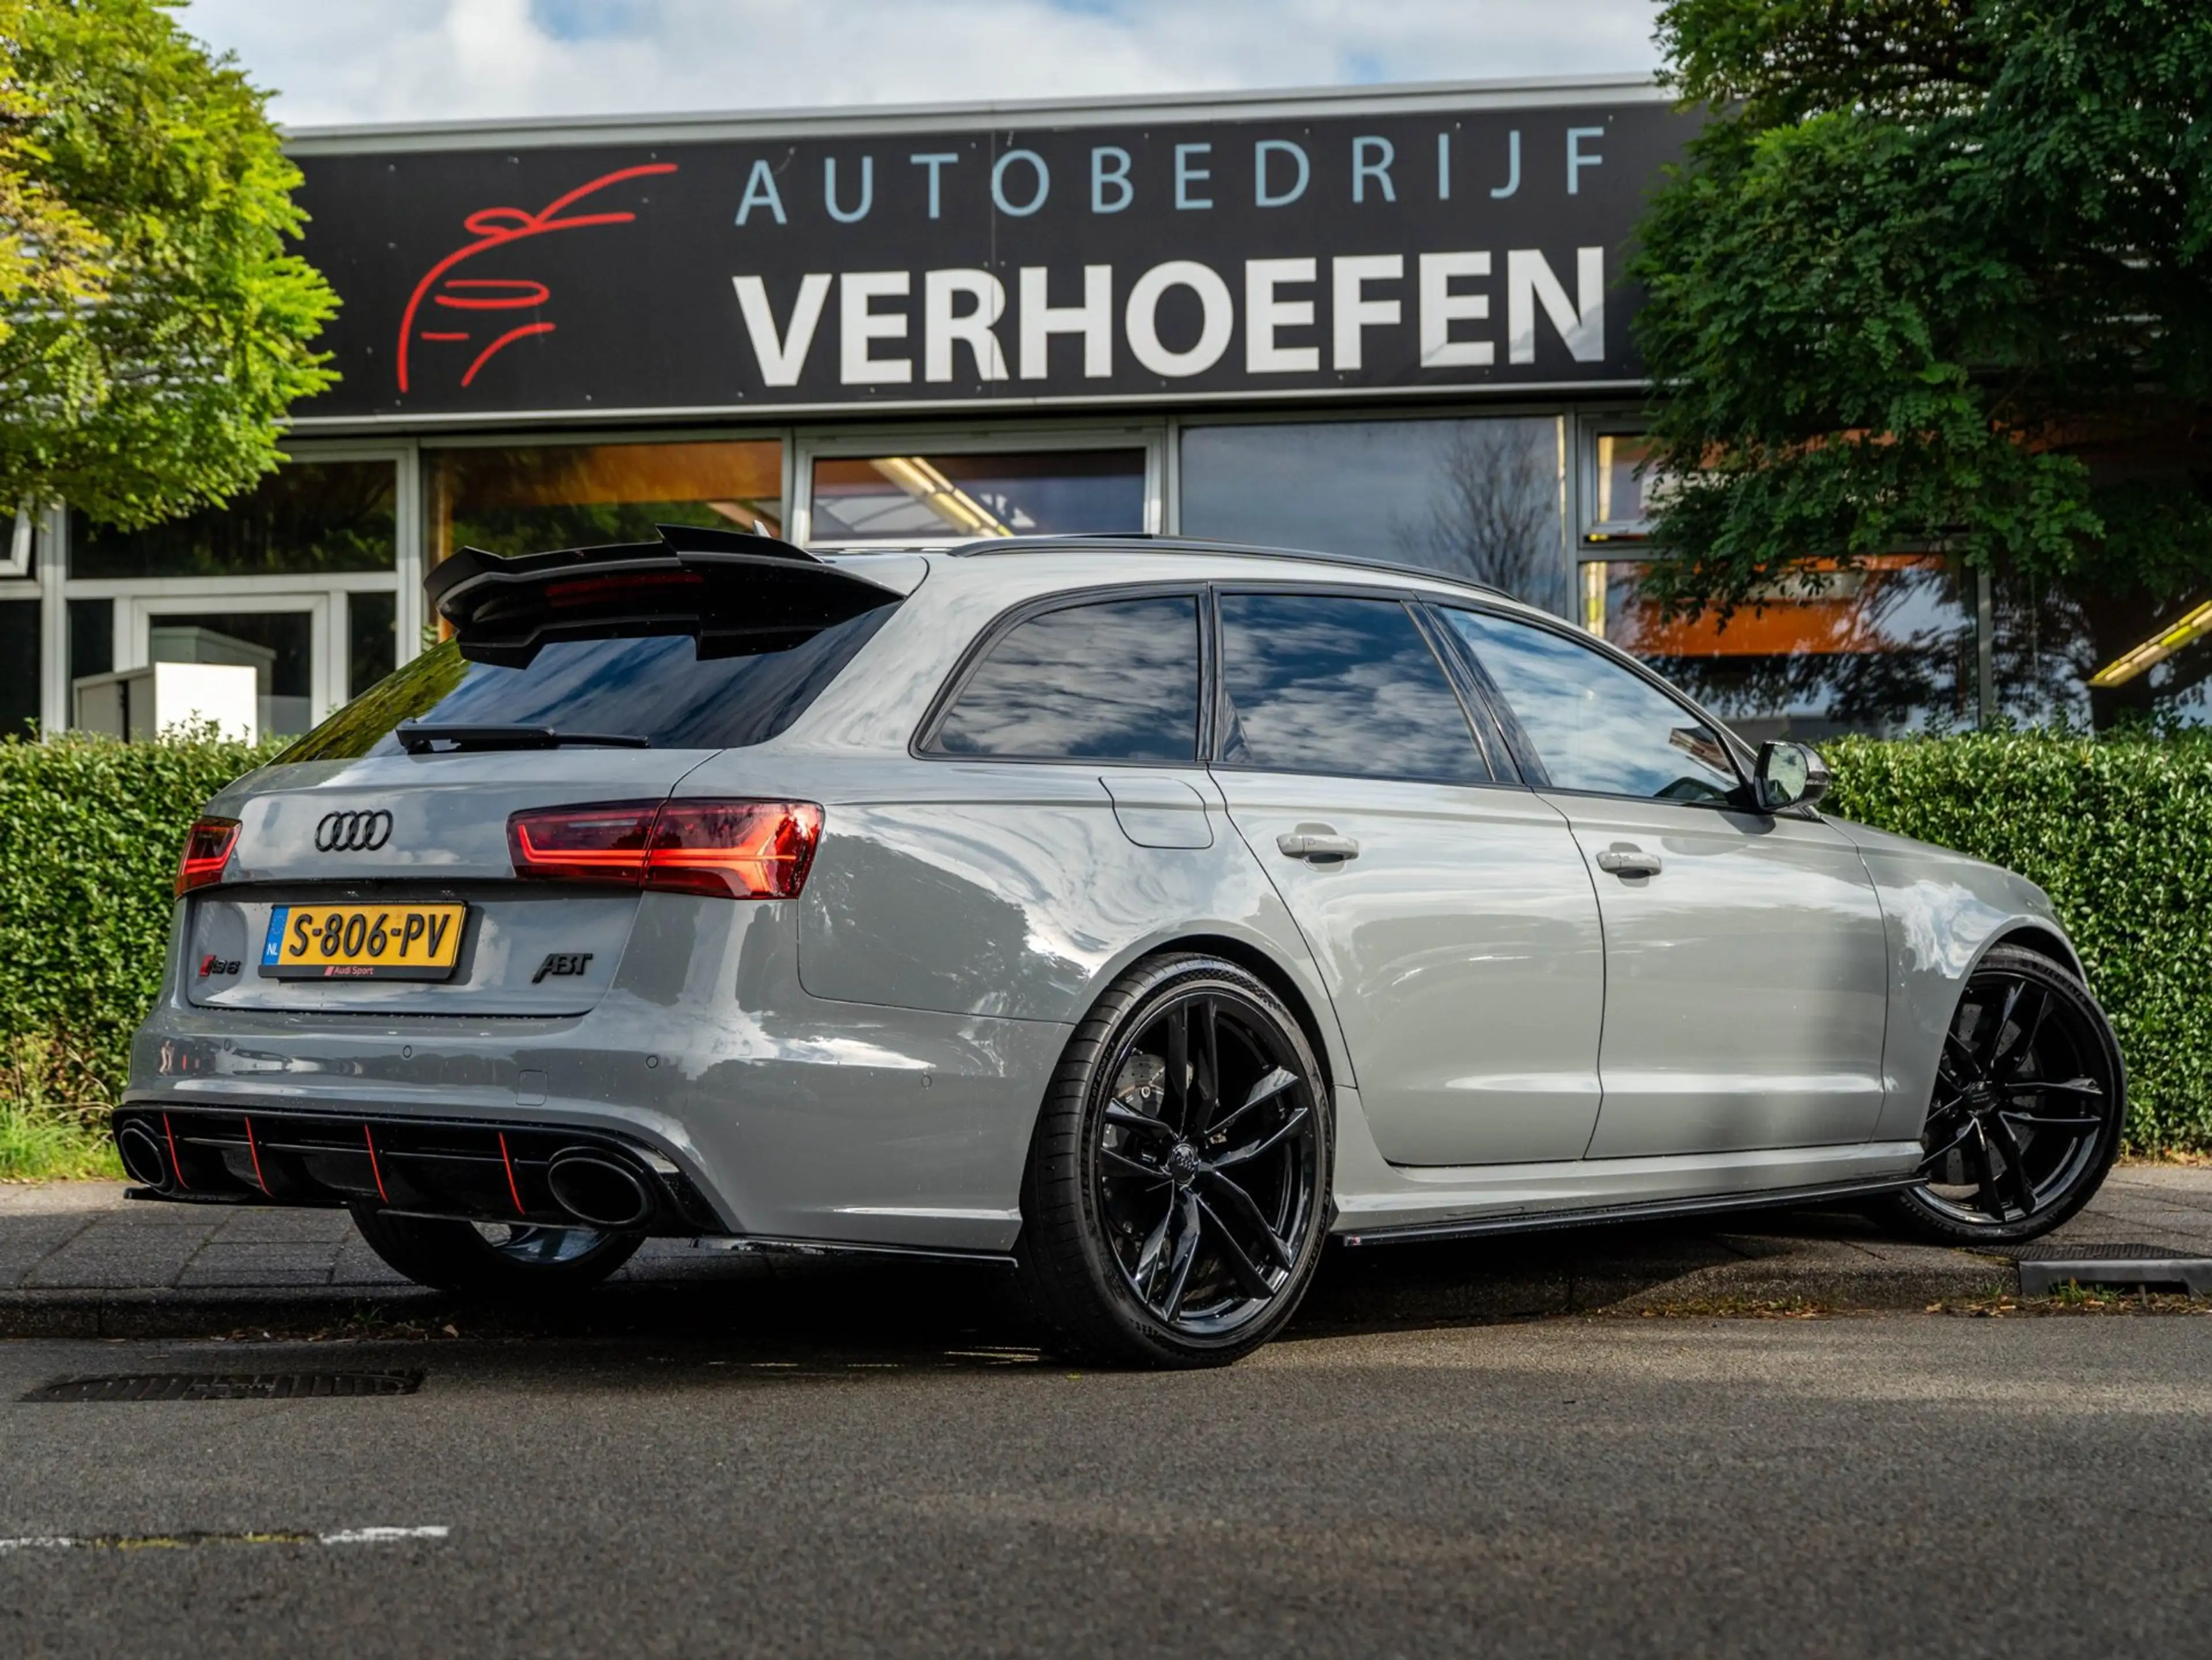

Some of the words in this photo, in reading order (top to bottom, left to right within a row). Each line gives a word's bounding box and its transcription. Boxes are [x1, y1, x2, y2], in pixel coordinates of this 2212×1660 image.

[735, 127, 1605, 226] AUTOBEDRIJF
[732, 247, 1605, 387] VERHOEFEN
[266, 942, 278, 956] NL
[289, 913, 451, 957] S-806-PV
[334, 966, 352, 975] Audi
[352, 966, 373, 976] Sport
[531, 952, 594, 984] ABT
